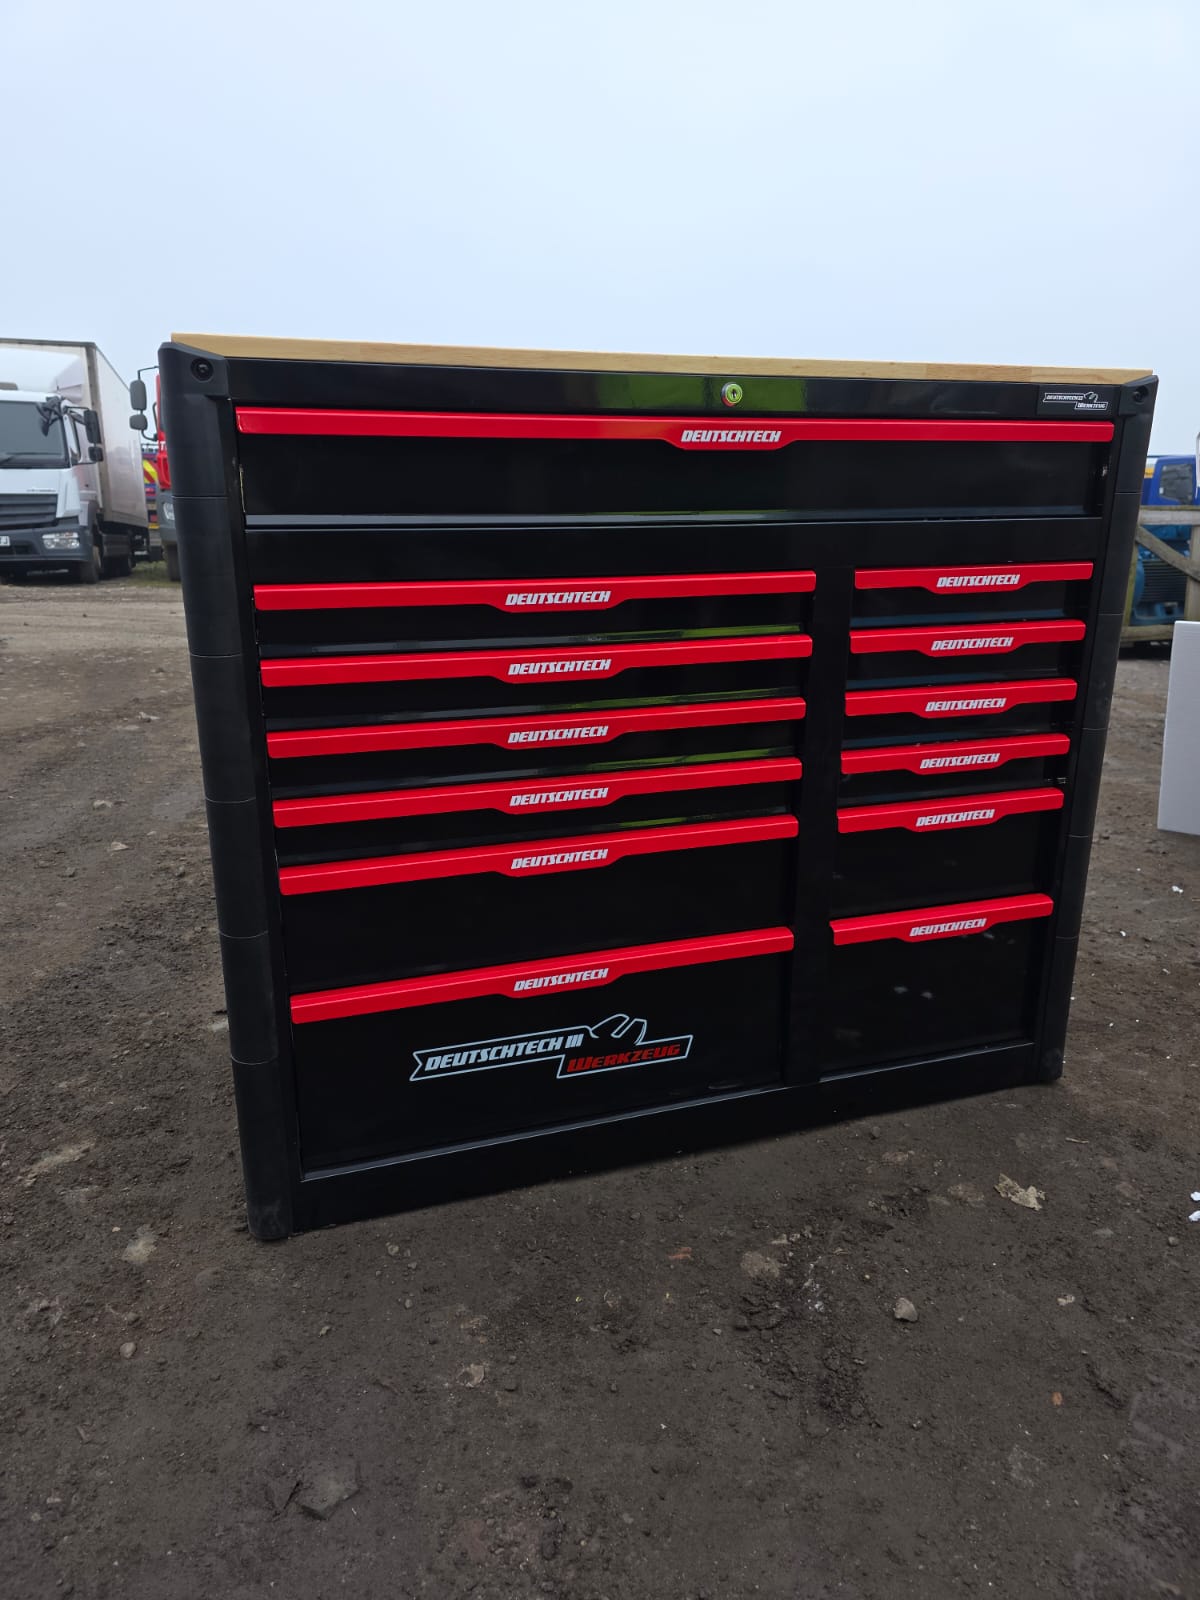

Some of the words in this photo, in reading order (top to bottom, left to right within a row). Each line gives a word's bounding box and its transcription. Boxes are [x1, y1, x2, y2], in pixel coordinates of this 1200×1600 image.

[681, 430, 781, 442] DEUTSCHTECH
[937, 575, 1021, 588] DEUTSCHTECH
[505, 590, 611, 606] DEUTSCHTECH
[931, 637, 1013, 650] DEUTSCHTECH
[508, 659, 611, 675] DEUTSCHTECH
[926, 698, 1007, 713] DEUTSCHTECH
[508, 725, 609, 744] DEUTSCHTECH
[920, 753, 1000, 769] DEUTSCHTECH
[510, 787, 609, 807] DEUTSCHTECH
[916, 809, 995, 827] DEUTSCHTECH
[511, 849, 608, 870] DEUTSCHTECH
[910, 918, 987, 936] DEUTSCHTECH
[514, 968, 609, 992] DEUTSCHTECH
[425, 1038, 561, 1070] DEUTSCHTECH
[567, 1044, 680, 1072] WERKZEUG
